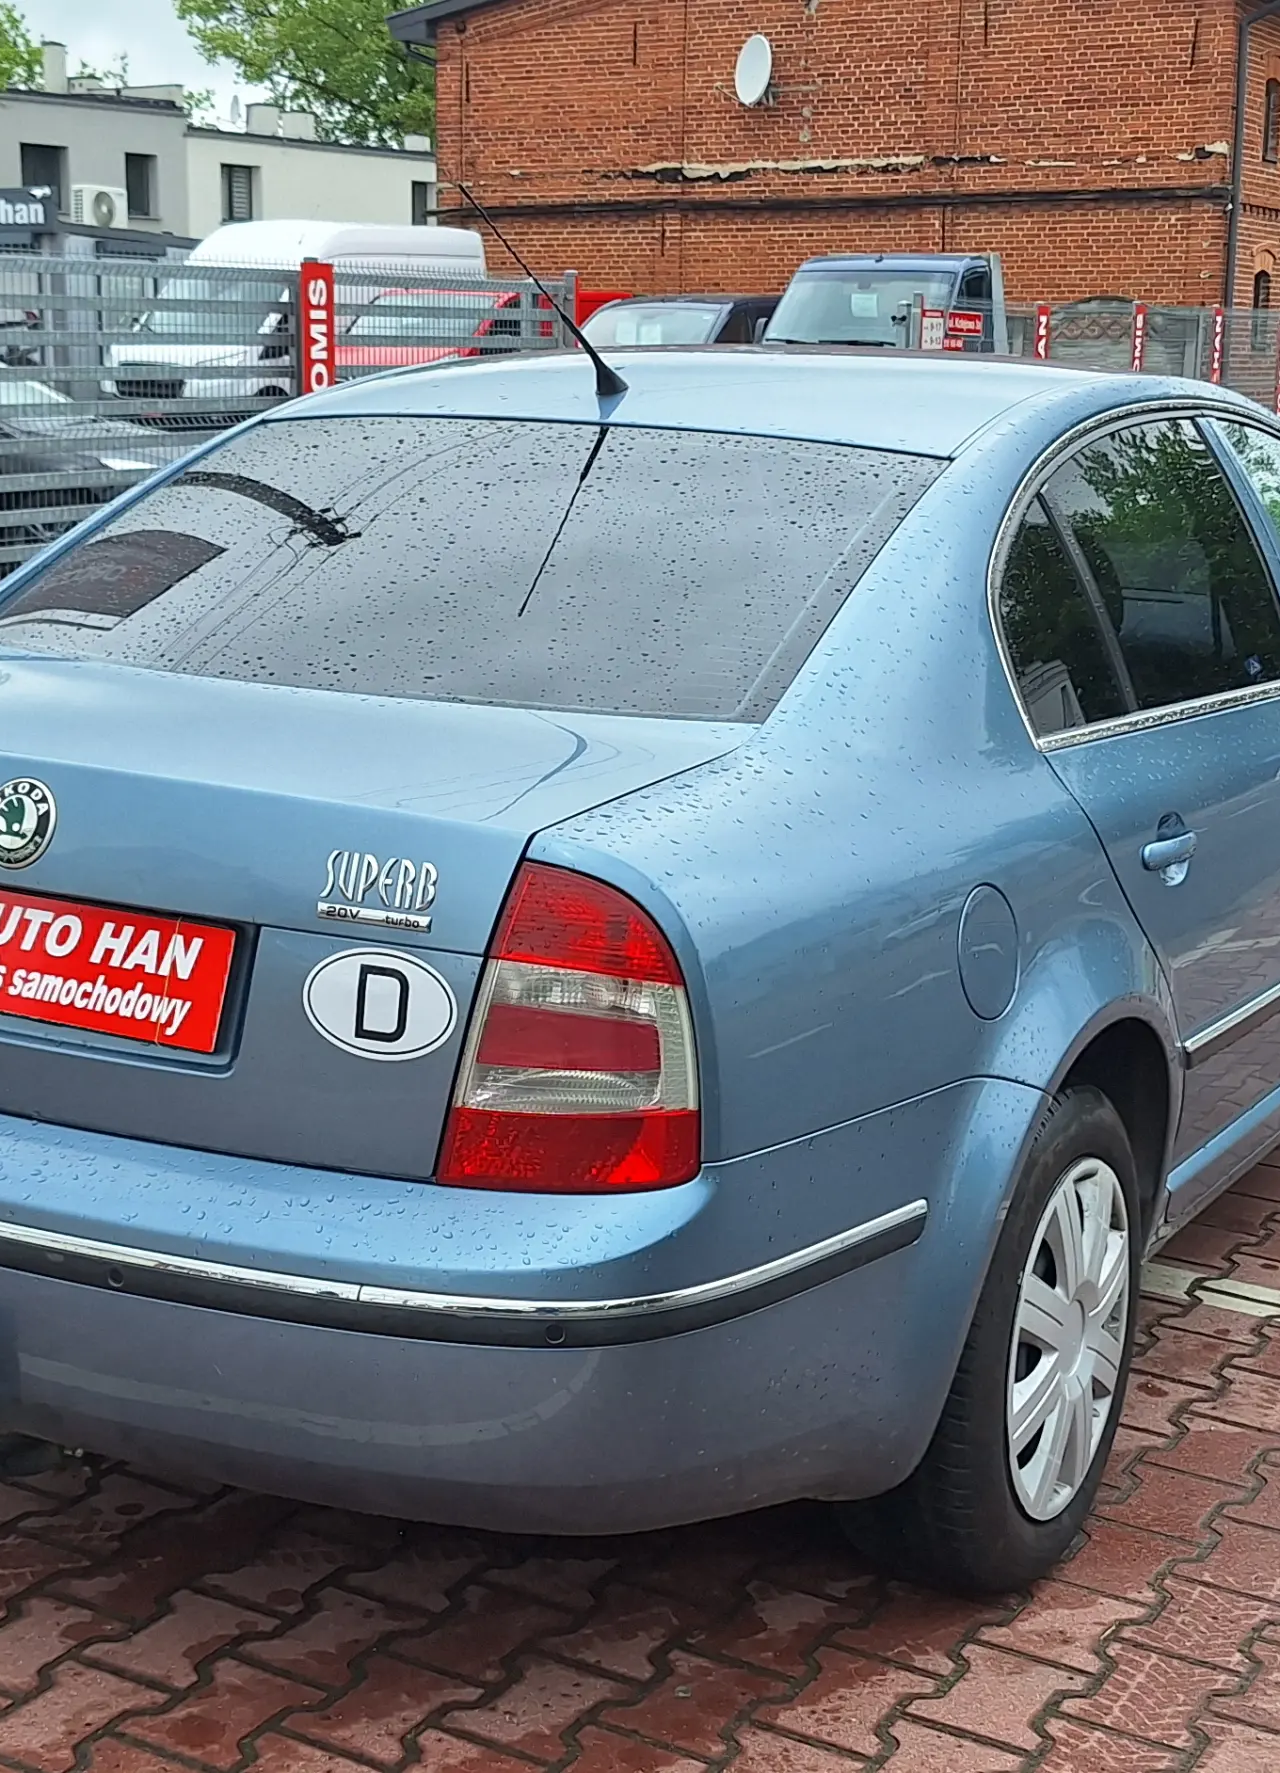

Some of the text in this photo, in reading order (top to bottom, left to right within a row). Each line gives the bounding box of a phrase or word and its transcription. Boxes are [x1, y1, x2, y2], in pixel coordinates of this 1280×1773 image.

[319, 849, 438, 912] SUPERB
[325, 905, 420, 929] 20V turbo
[89, 920, 204, 981] HAN
[7, 967, 193, 1037] samochodowy
[354, 963, 410, 1043] D
